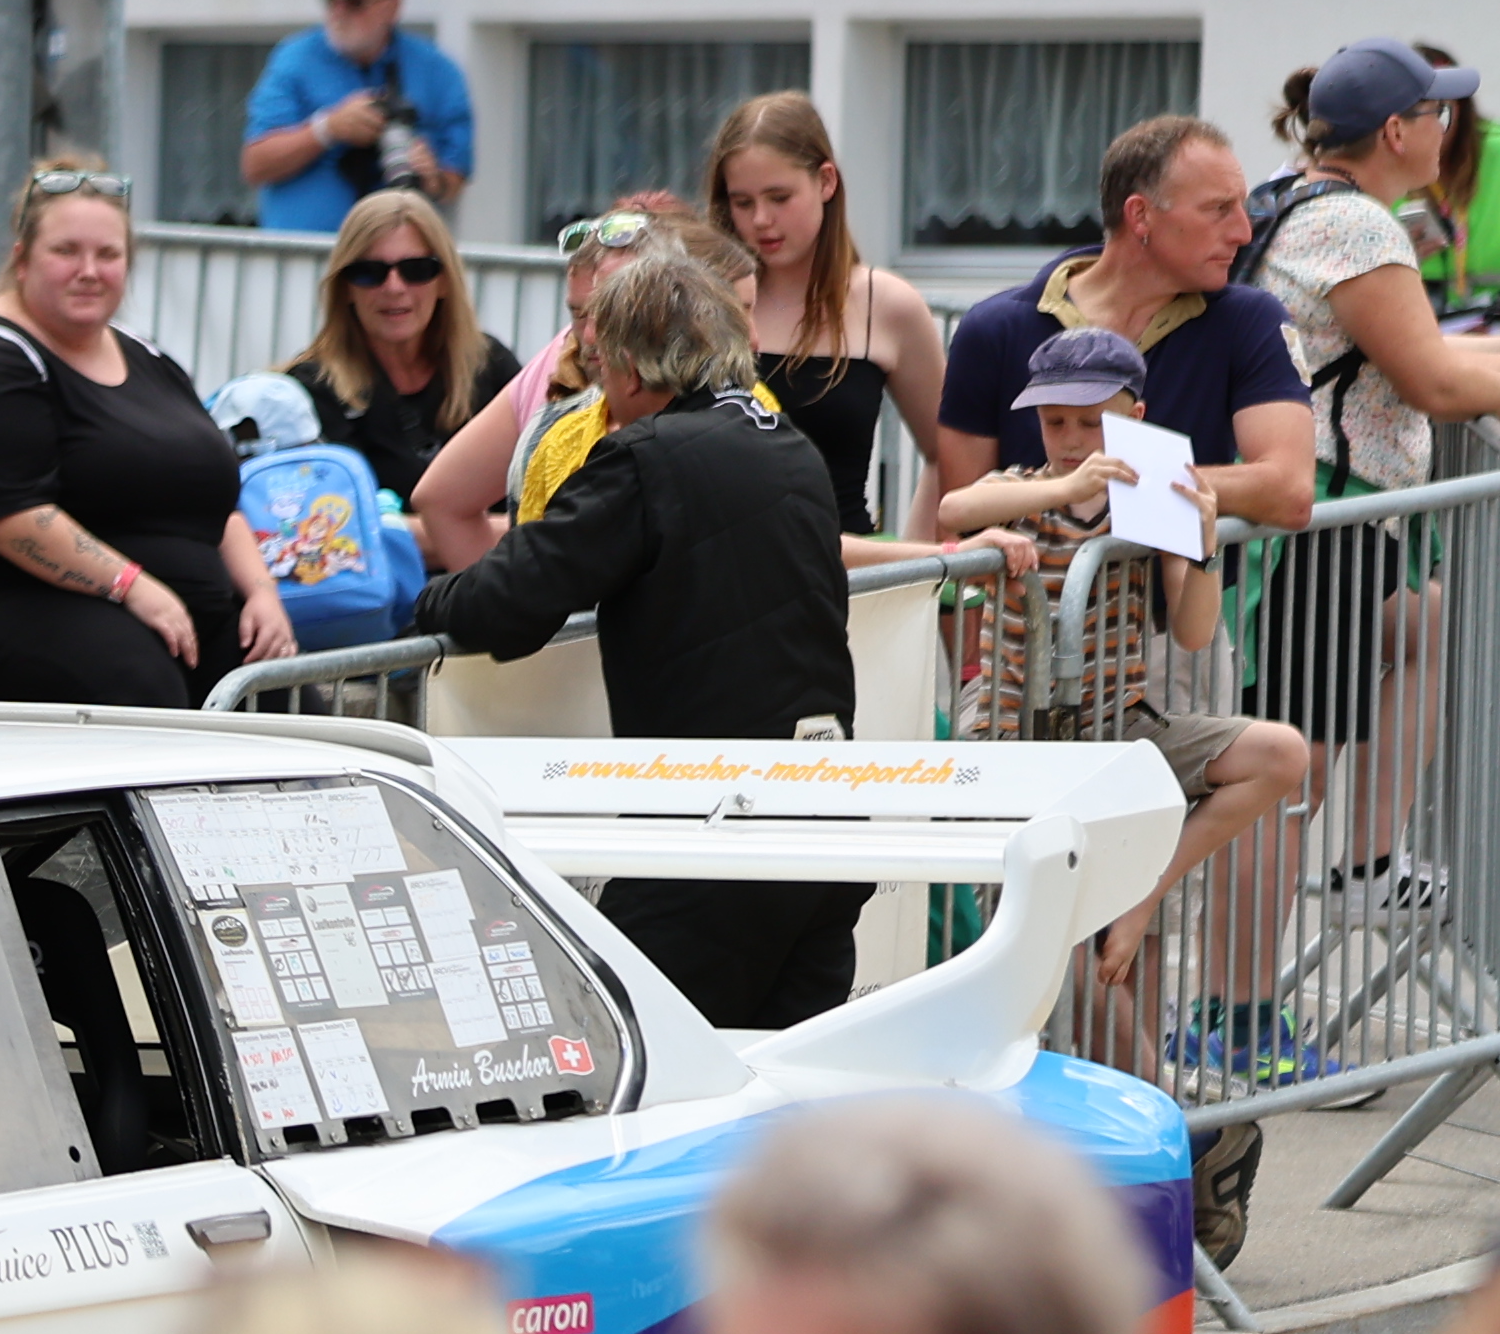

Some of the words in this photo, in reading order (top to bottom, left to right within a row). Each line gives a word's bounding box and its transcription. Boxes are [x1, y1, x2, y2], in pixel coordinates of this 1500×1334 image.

[567, 754, 749, 783] www.buschor
[764, 757, 955, 791] motorsport.ch
[411, 1057, 473, 1098] Armin
[474, 1044, 553, 1086] Buschor
[512, 1298, 588, 1334] caron
